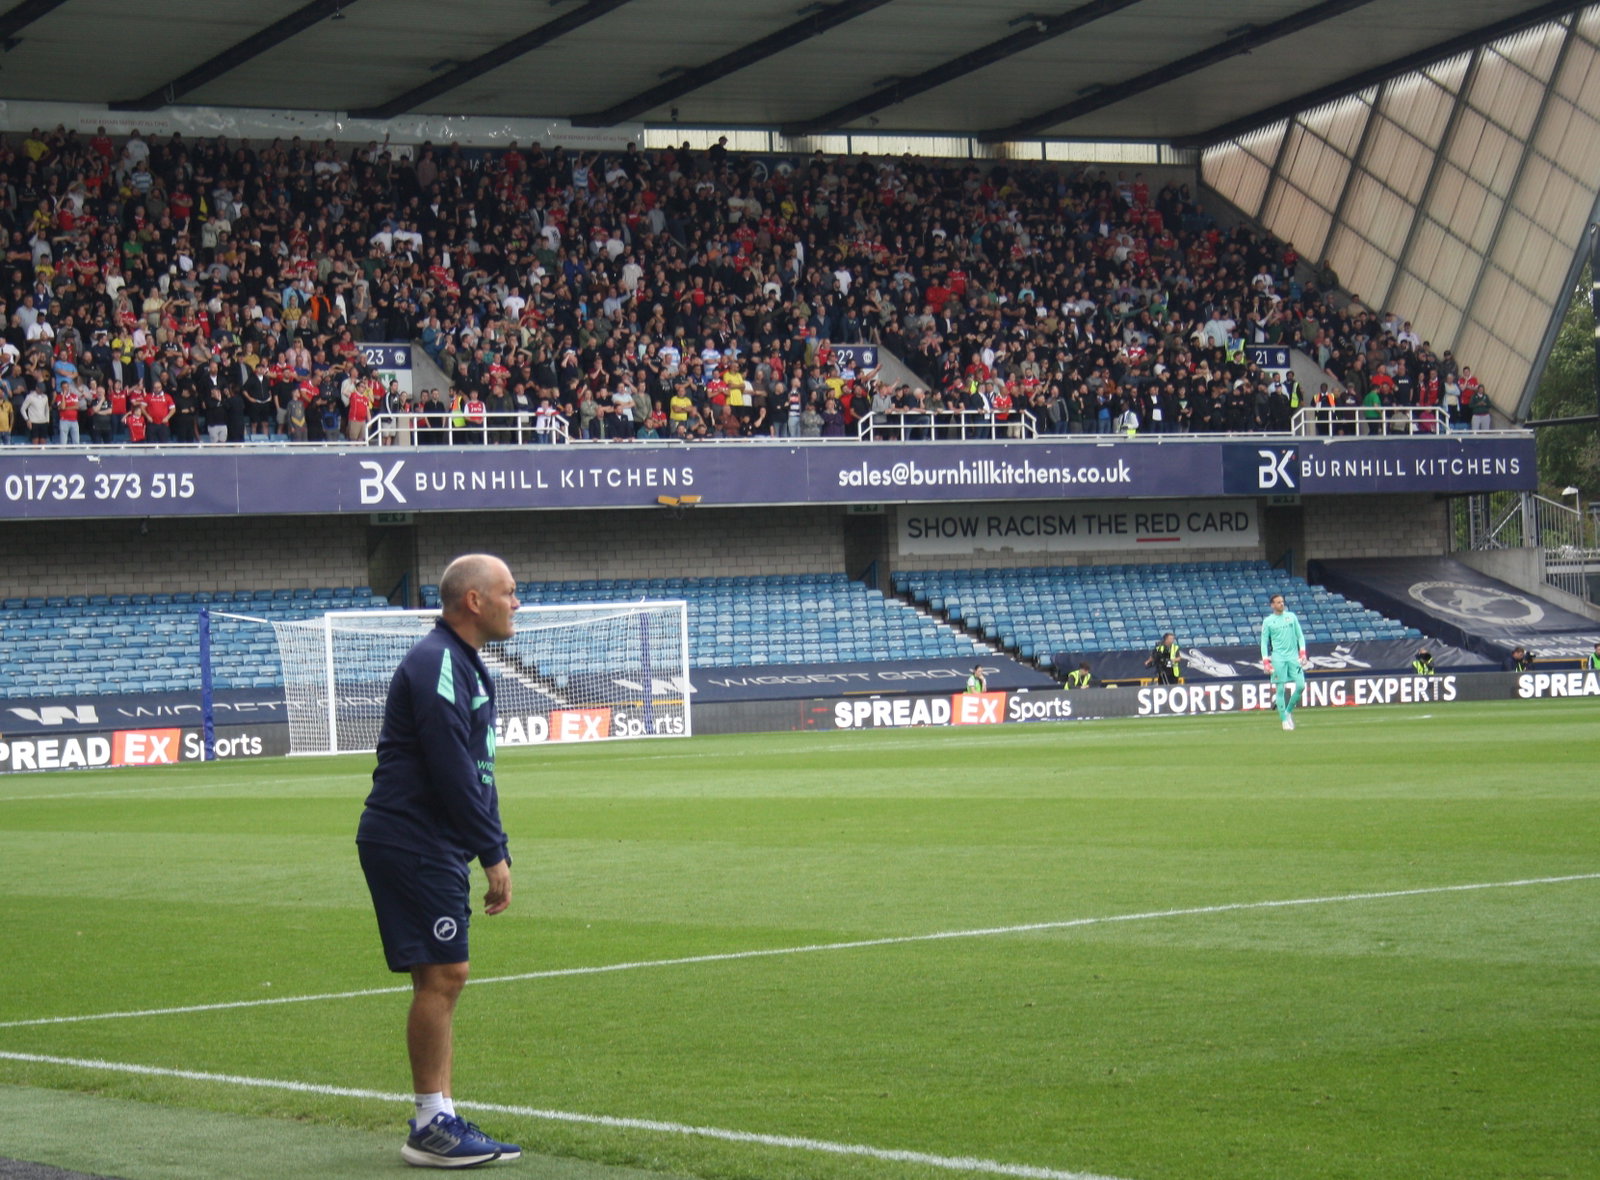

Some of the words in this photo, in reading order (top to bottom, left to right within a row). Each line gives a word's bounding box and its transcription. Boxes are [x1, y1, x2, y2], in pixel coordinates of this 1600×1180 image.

[365, 349, 385, 366] 23
[1255, 350, 1269, 365] 21
[415, 470, 549, 492] BURNHILL
[561, 467, 695, 488] KITCHENS
[838, 458, 1131, 487] sales@burnhillkitchens.co.uk
[1302, 459, 1406, 478] BURNHILL
[1415, 458, 1520, 476] KITCHENS
[5, 474, 86, 501] 01732
[94, 473, 142, 499] 373
[151, 472, 195, 499] 515
[907, 516, 980, 539] SHOW
[986, 514, 1077, 537] RACISM
[1082, 513, 1129, 535] THE
[1135, 512, 1182, 533] RED
[1187, 511, 1250, 533] CARD
[708, 672, 869, 688] WIGGETT
[1137, 684, 1235, 716] SPORTS
[1354, 675, 1457, 705] EXPERTS
[834, 698, 951, 728] SPREAD
[1009, 695, 1072, 722] Sports
